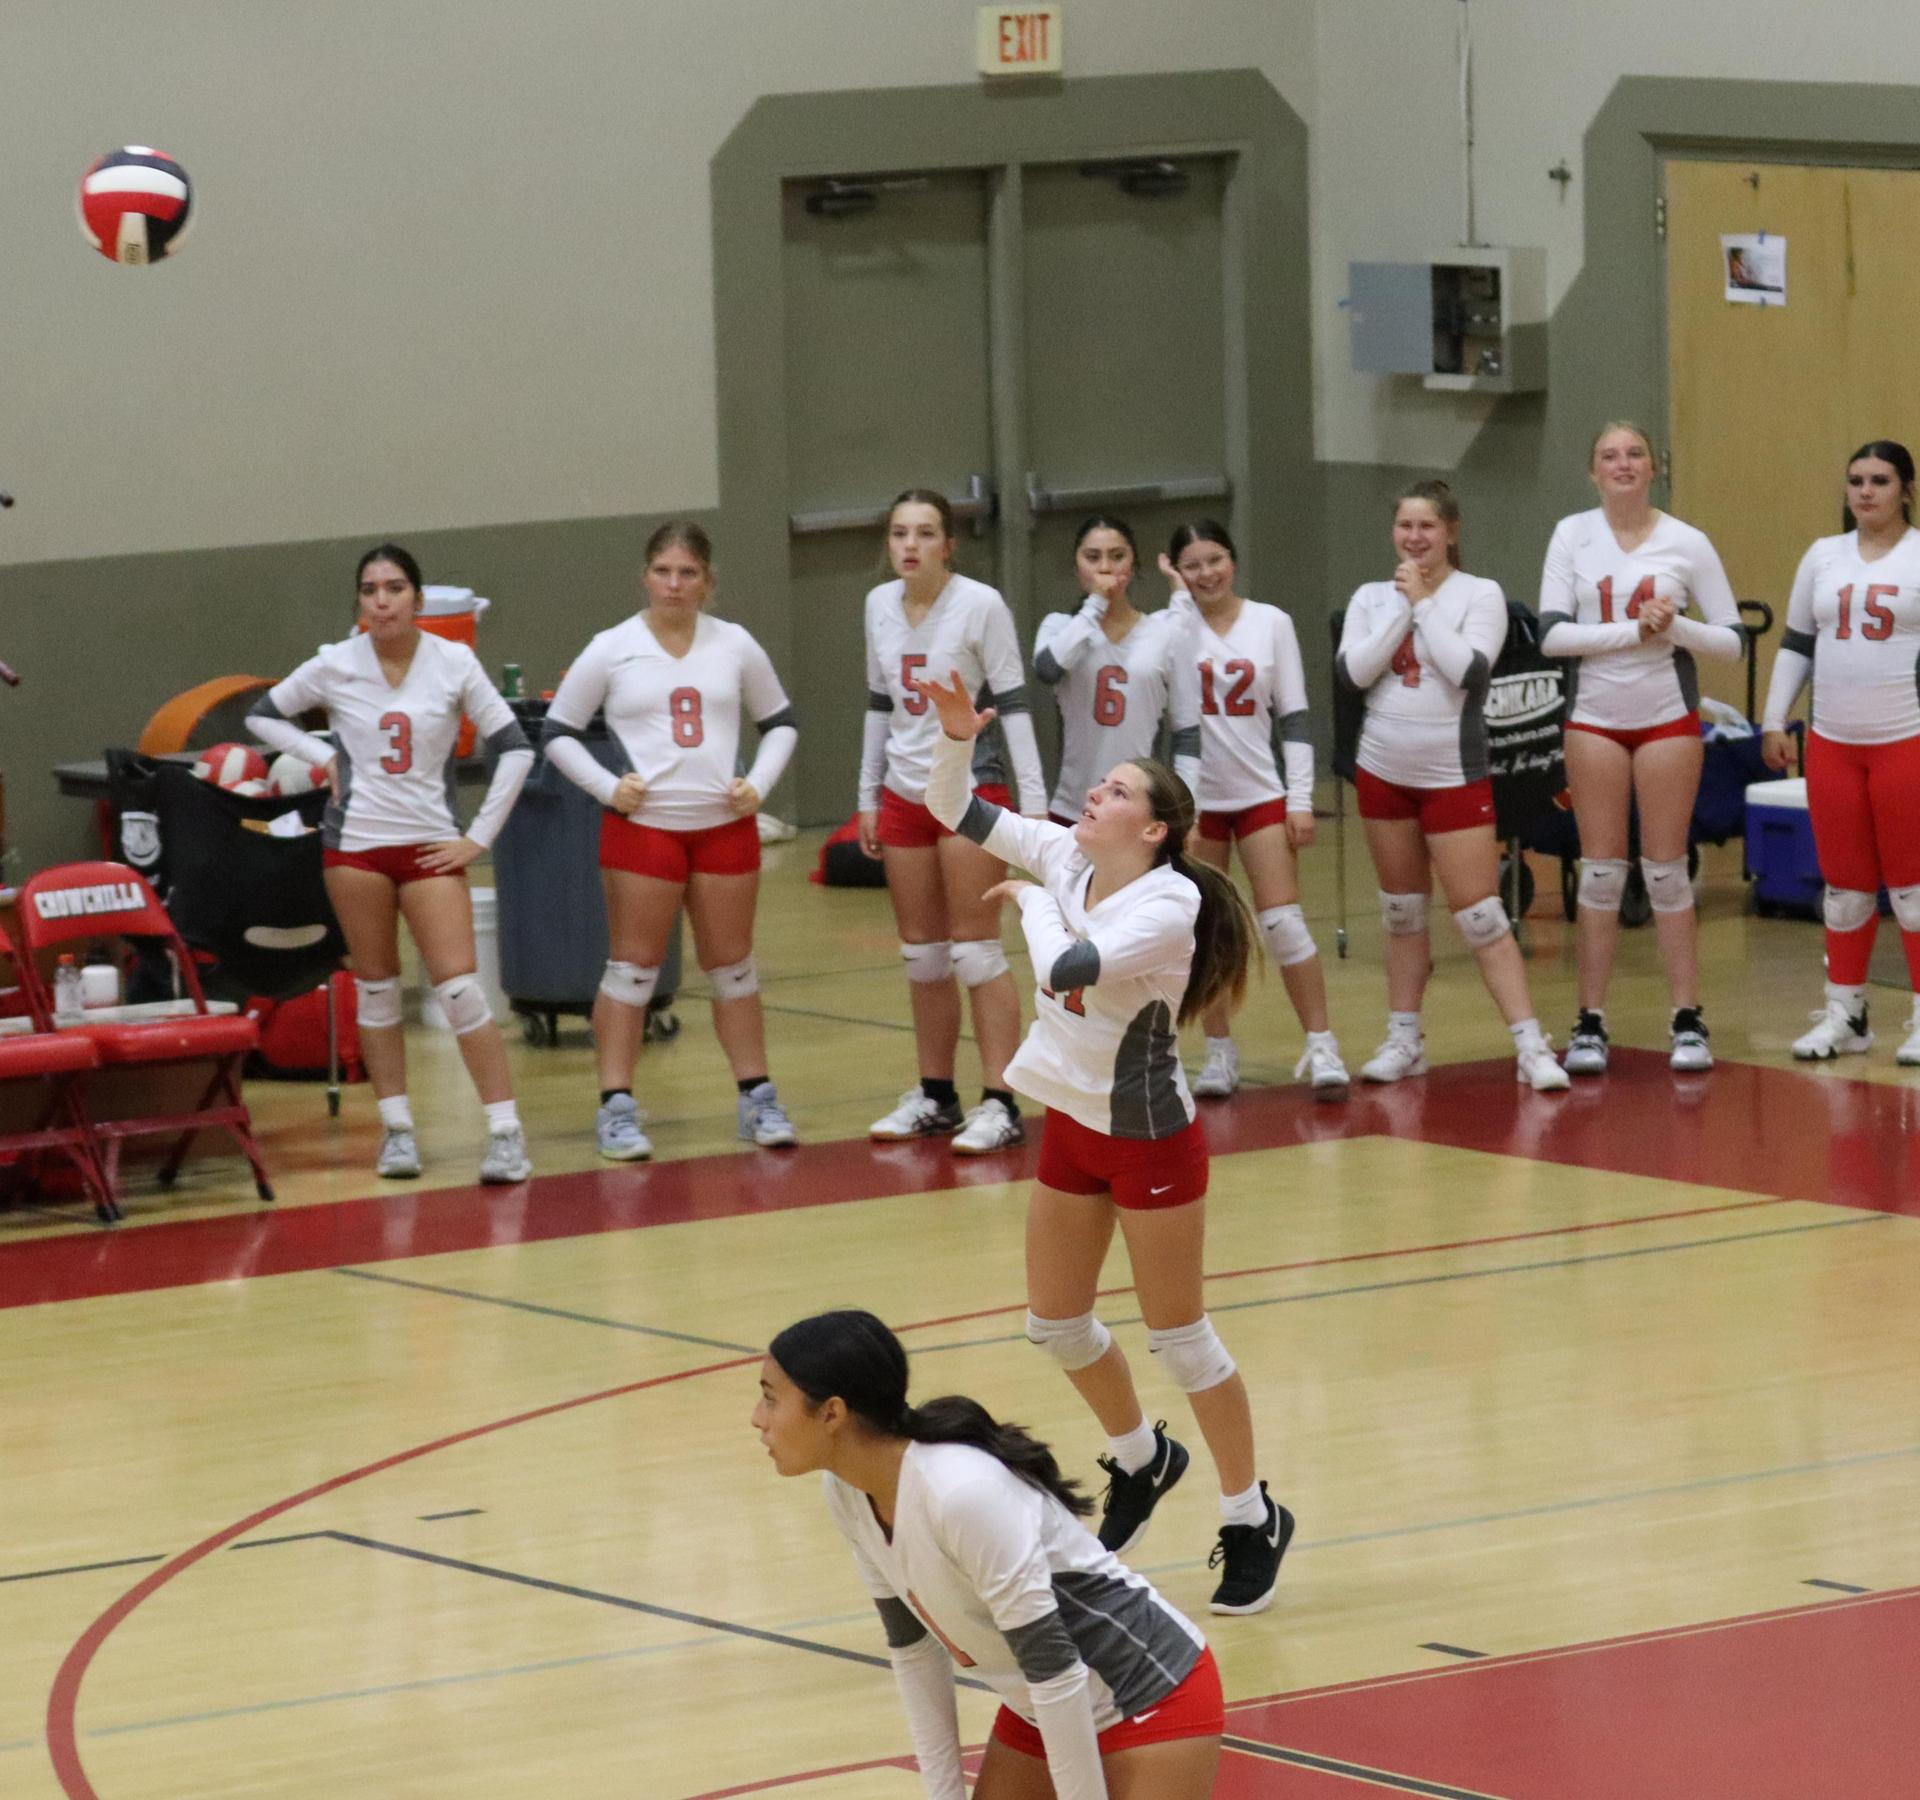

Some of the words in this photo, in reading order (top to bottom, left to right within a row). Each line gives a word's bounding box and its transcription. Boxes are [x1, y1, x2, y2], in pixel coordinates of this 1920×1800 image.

[998, 13, 1050, 63] EXIT
[1597, 575, 1655, 624] 14
[1835, 583, 1899, 641] 15
[901, 654, 928, 716] 5
[1197, 658, 1256, 716] 12
[1391, 629, 1421, 688] 4
[669, 686, 704, 748] 8
[1093, 665, 1128, 727] 6
[379, 711, 412, 774] 3
[34, 882, 146, 920] CHOWCHILLA
